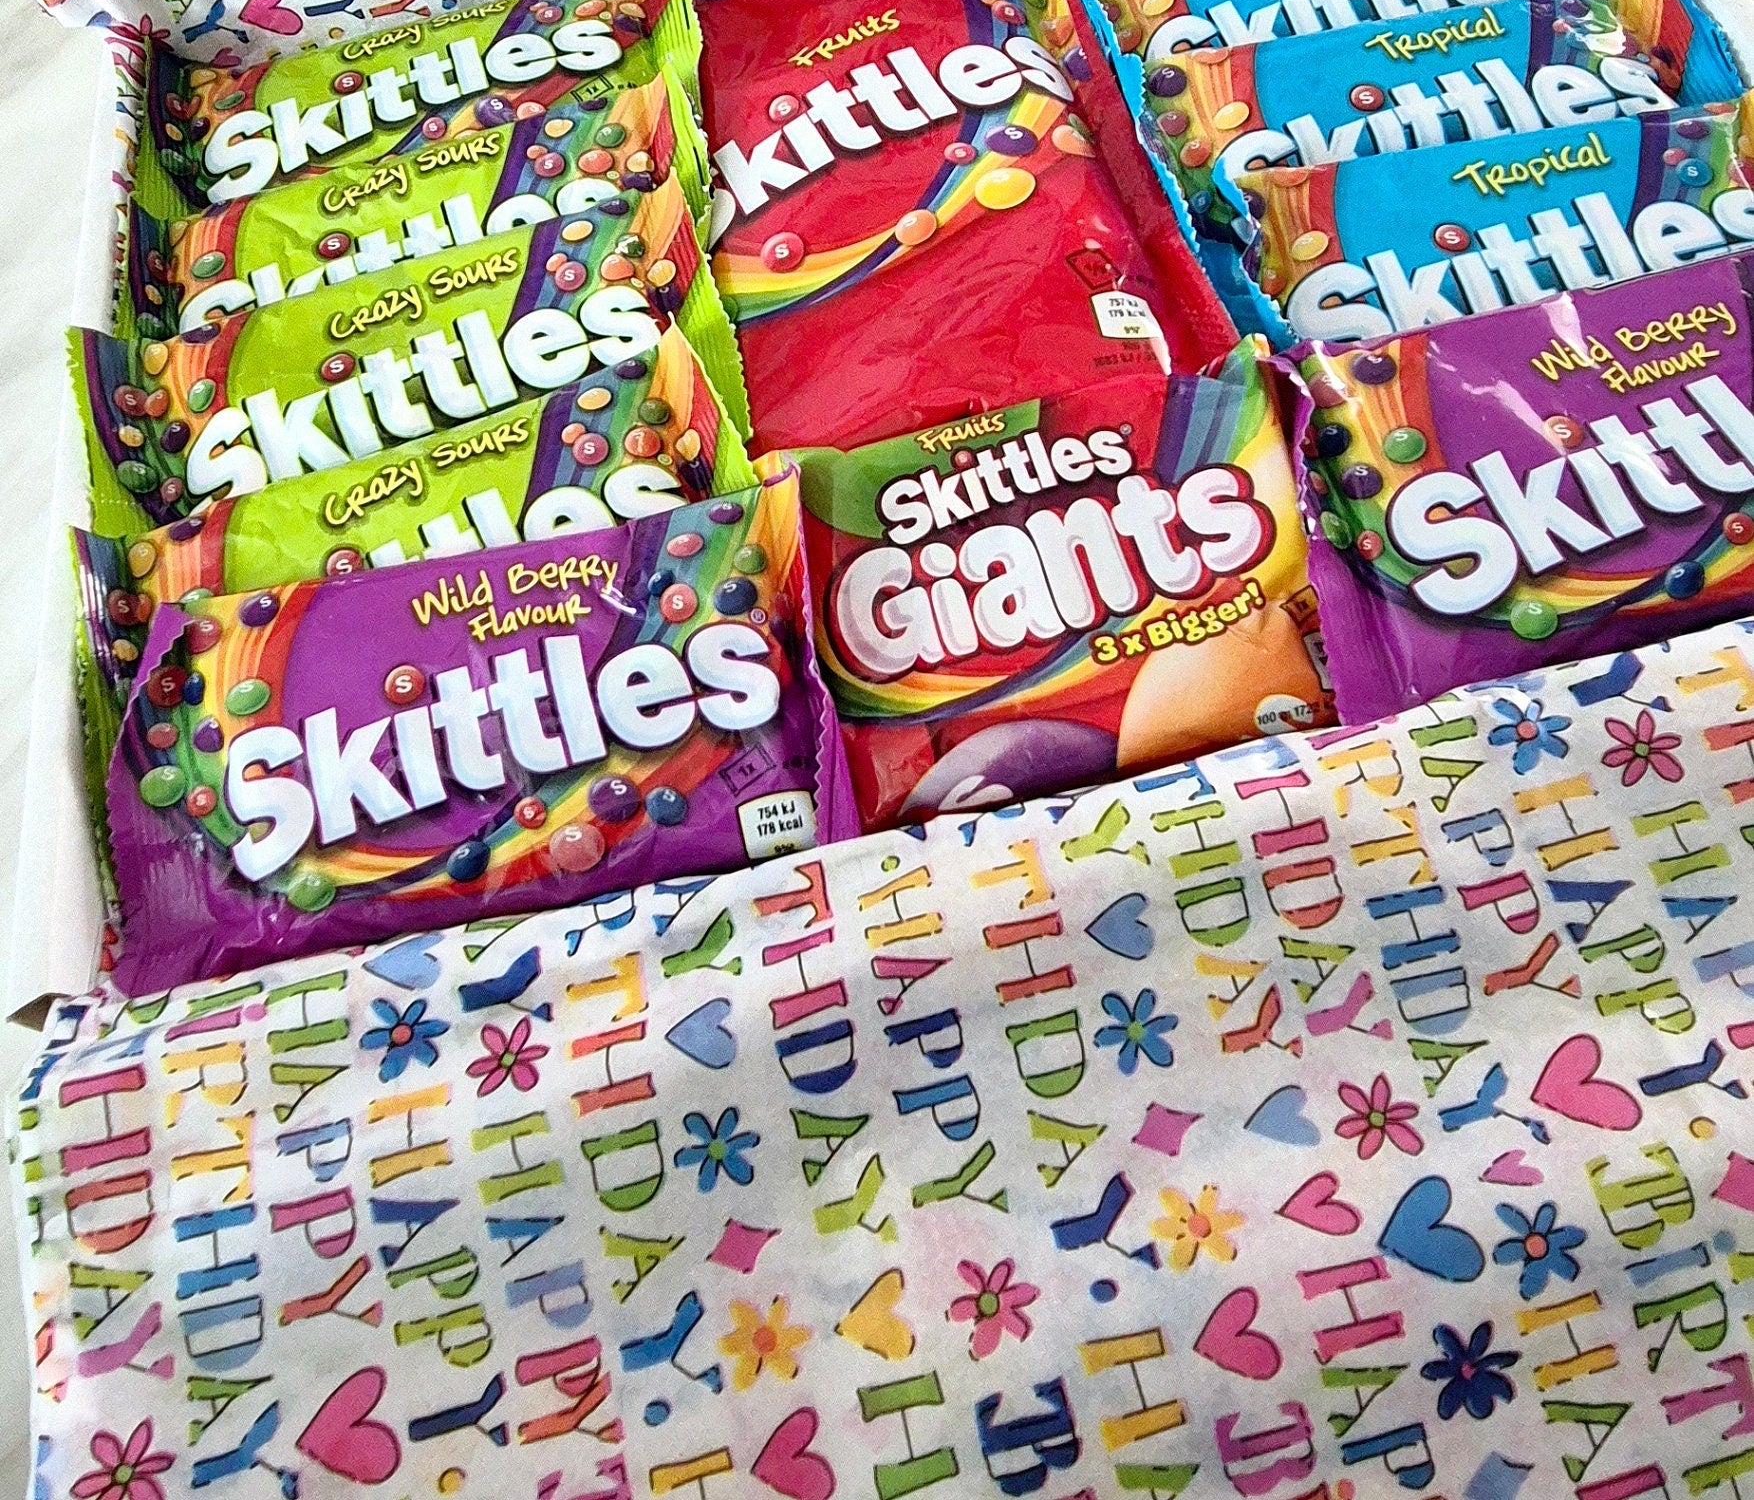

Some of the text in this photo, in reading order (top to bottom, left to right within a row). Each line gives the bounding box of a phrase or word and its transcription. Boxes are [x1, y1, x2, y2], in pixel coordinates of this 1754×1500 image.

[788, 8, 901, 69] Fruits
[1364, 10, 1505, 62] Tropical
[203, 22, 622, 203] Skittles
[1452, 132, 1611, 195] Tropical
[1532, 301, 1737, 381] Wild Berry
[1600, 341, 1721, 393] Flavour
[187, 286, 661, 499] Skittles
[915, 414, 1006, 453] Fruits
[880, 429, 1133, 545] Skittles
[412, 555, 619, 626] Wild Berry
[836, 468, 1264, 675] Giants
[469, 592, 591, 641] Flavour
[1094, 634, 1119, 662] 3
[1151, 582, 1264, 647] Bigger!
[229, 622, 780, 882] Skittles
[756, 814, 804, 837] 178 kcal
[757, 804, 778, 820] 754
[1514, 772, 1748, 1099] HAPPY
[859, 865, 1009, 1213] HAPPY
[267, 970, 384, 1328] HAPPY
[367, 1083, 510, 1447] HAPPY
[470, 1111, 626, 1446] HAPPY
